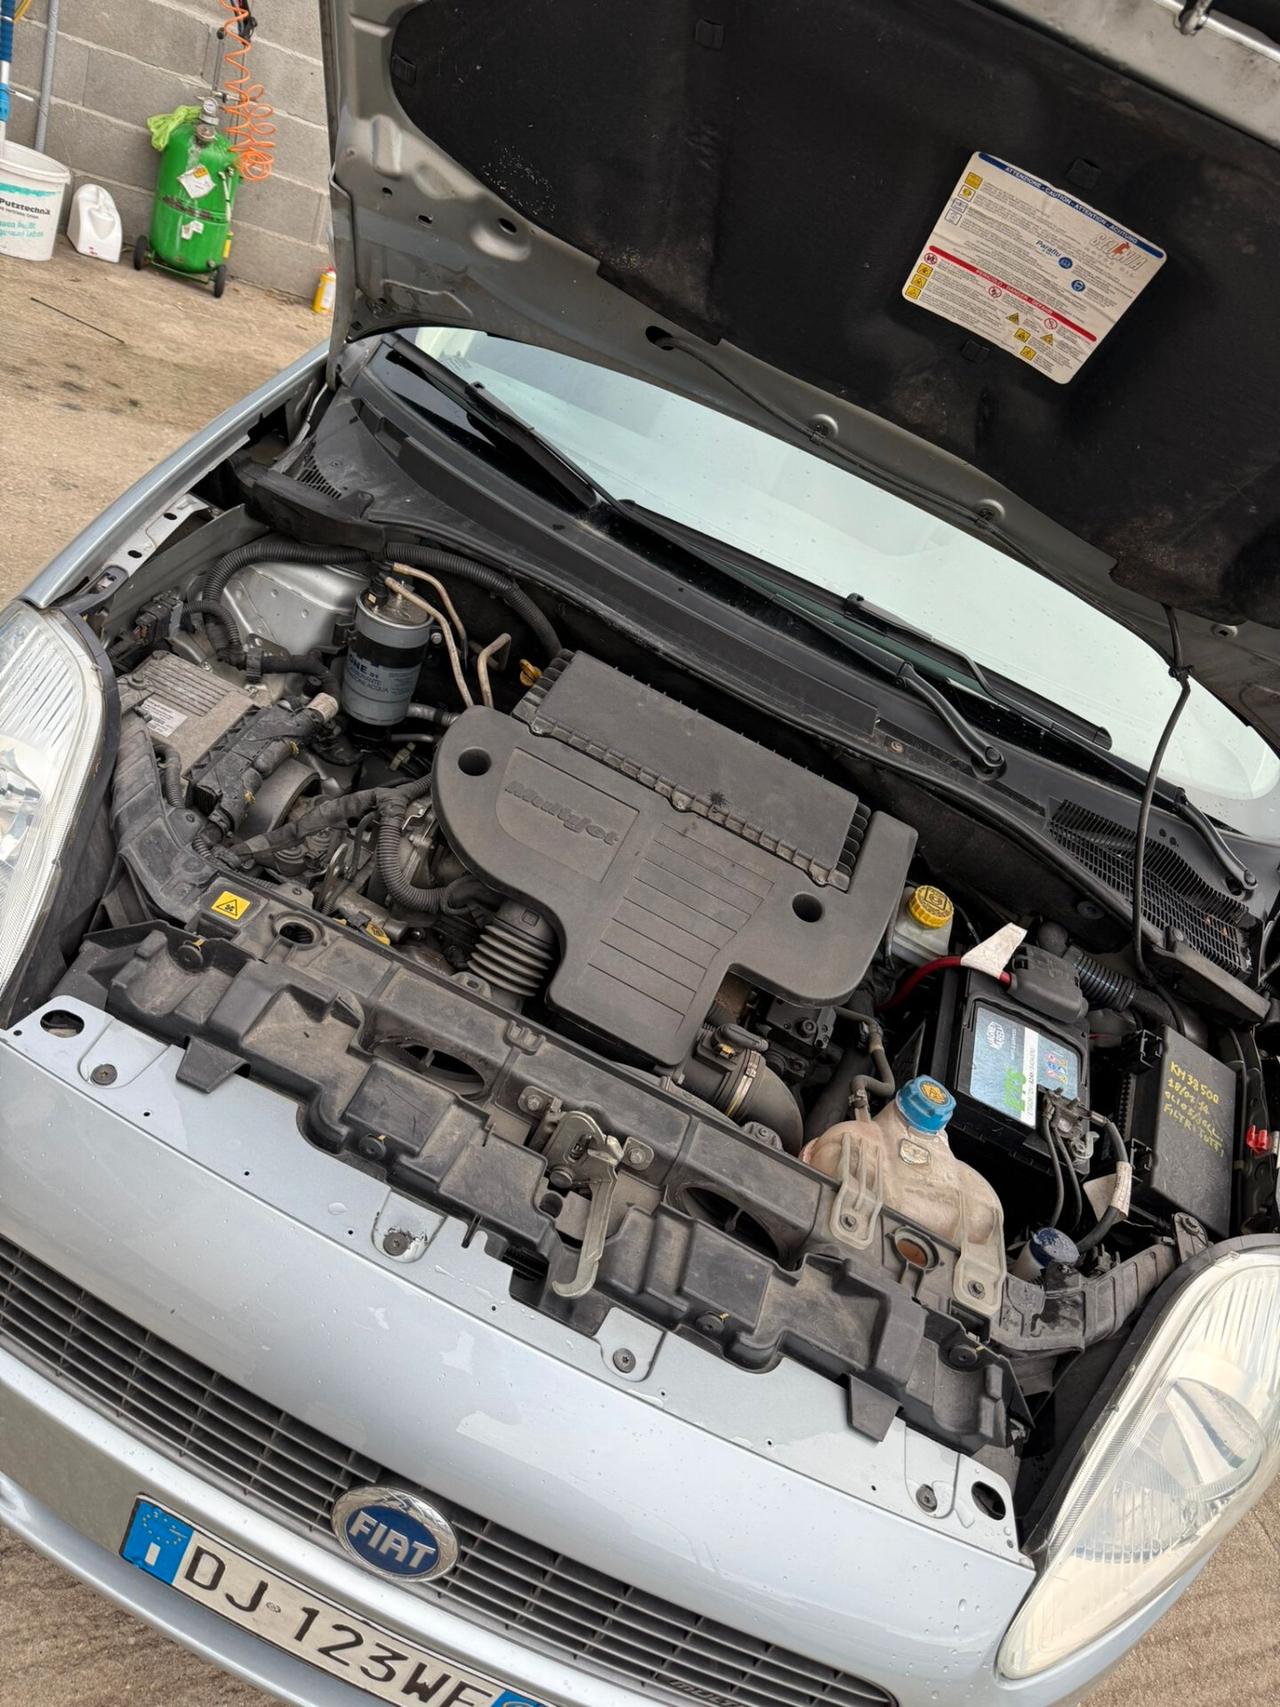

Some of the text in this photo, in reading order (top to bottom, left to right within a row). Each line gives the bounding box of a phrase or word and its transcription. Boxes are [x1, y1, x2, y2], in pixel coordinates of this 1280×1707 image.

[1004, 165, 1042, 190] ATTENZIONE
[1044, 186, 1072, 206] CAUTION
[1073, 202, 1107, 226] ATTENTION
[1109, 223, 1139, 245] ACHTUNG
[1035, 239, 1062, 258] Paraflu
[348, 1510, 437, 1569] FIAT
[183, 1545, 270, 1613] DJ
